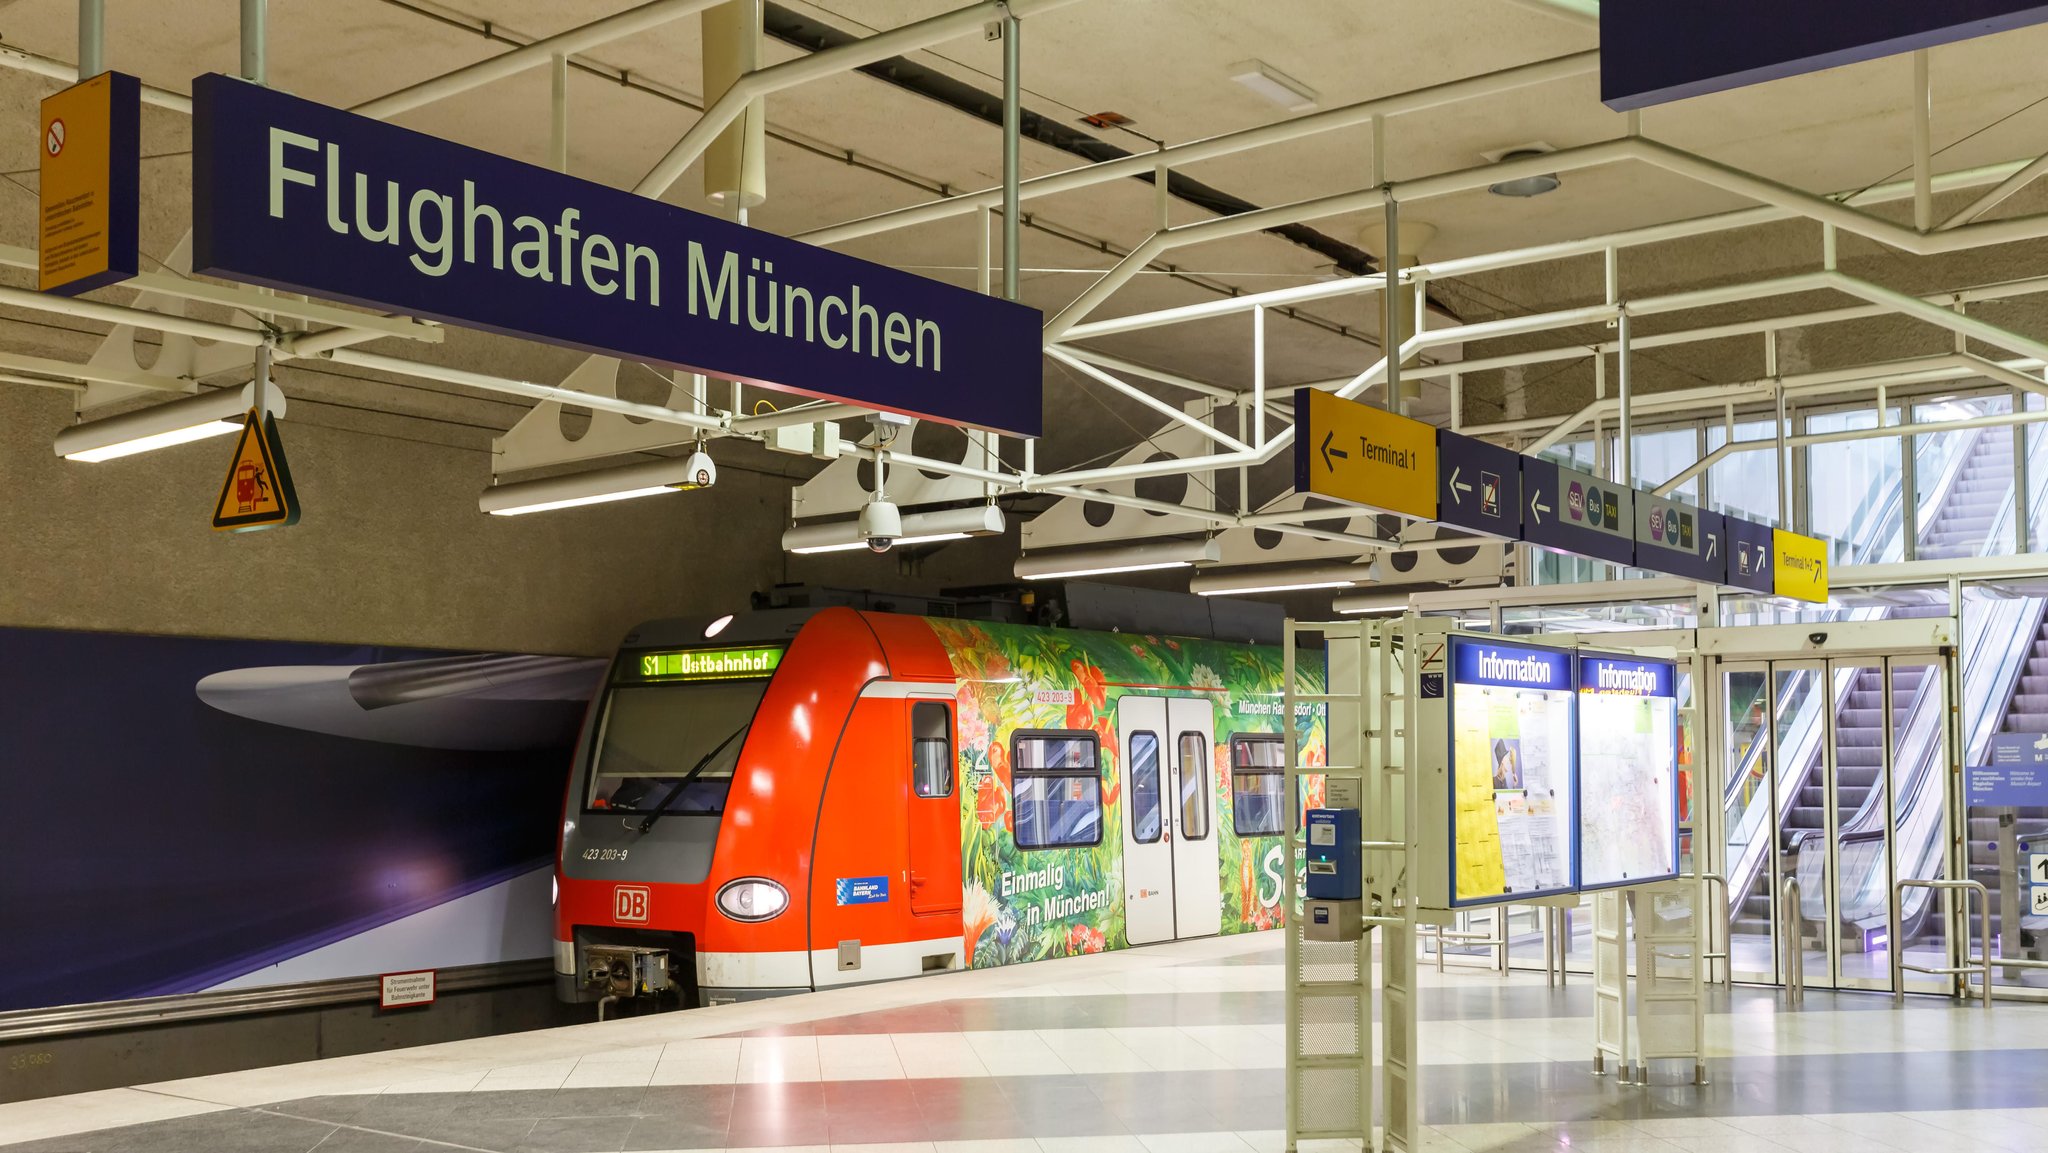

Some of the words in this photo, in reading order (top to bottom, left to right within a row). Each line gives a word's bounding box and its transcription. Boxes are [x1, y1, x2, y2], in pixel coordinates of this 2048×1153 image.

[269, 126, 660, 306] Flughafen
[688, 239, 941, 371] München
[1360, 436, 1409, 470] Terminal
[1411, 451, 1416, 471] 1
[1569, 491, 1583, 508] SEV
[1589, 500, 1600, 513] Bus
[1605, 504, 1617, 519] TAXI
[1651, 514, 1663, 529] SEV
[1667, 522, 1677, 534] Bus
[1681, 525, 1692, 538] TAXI
[1783, 552, 1805, 571] Terminal
[644, 655, 659, 675] S1
[682, 652, 769, 674] Ostbahnhof
[1479, 650, 1551, 683] Information
[1598, 662, 1657, 691] Information
[1037, 691, 1050, 703] 423
[1052, 691, 1073, 703] 203-9
[1238, 700, 1271, 715] München
[582, 849, 599, 860] 423
[600, 849, 628, 860] 203-9
[1001, 863, 1064, 897] Einmalig
[618, 891, 645, 917] DB
[1027, 902, 1041, 926] in
[1044, 883, 1110, 921] München!
